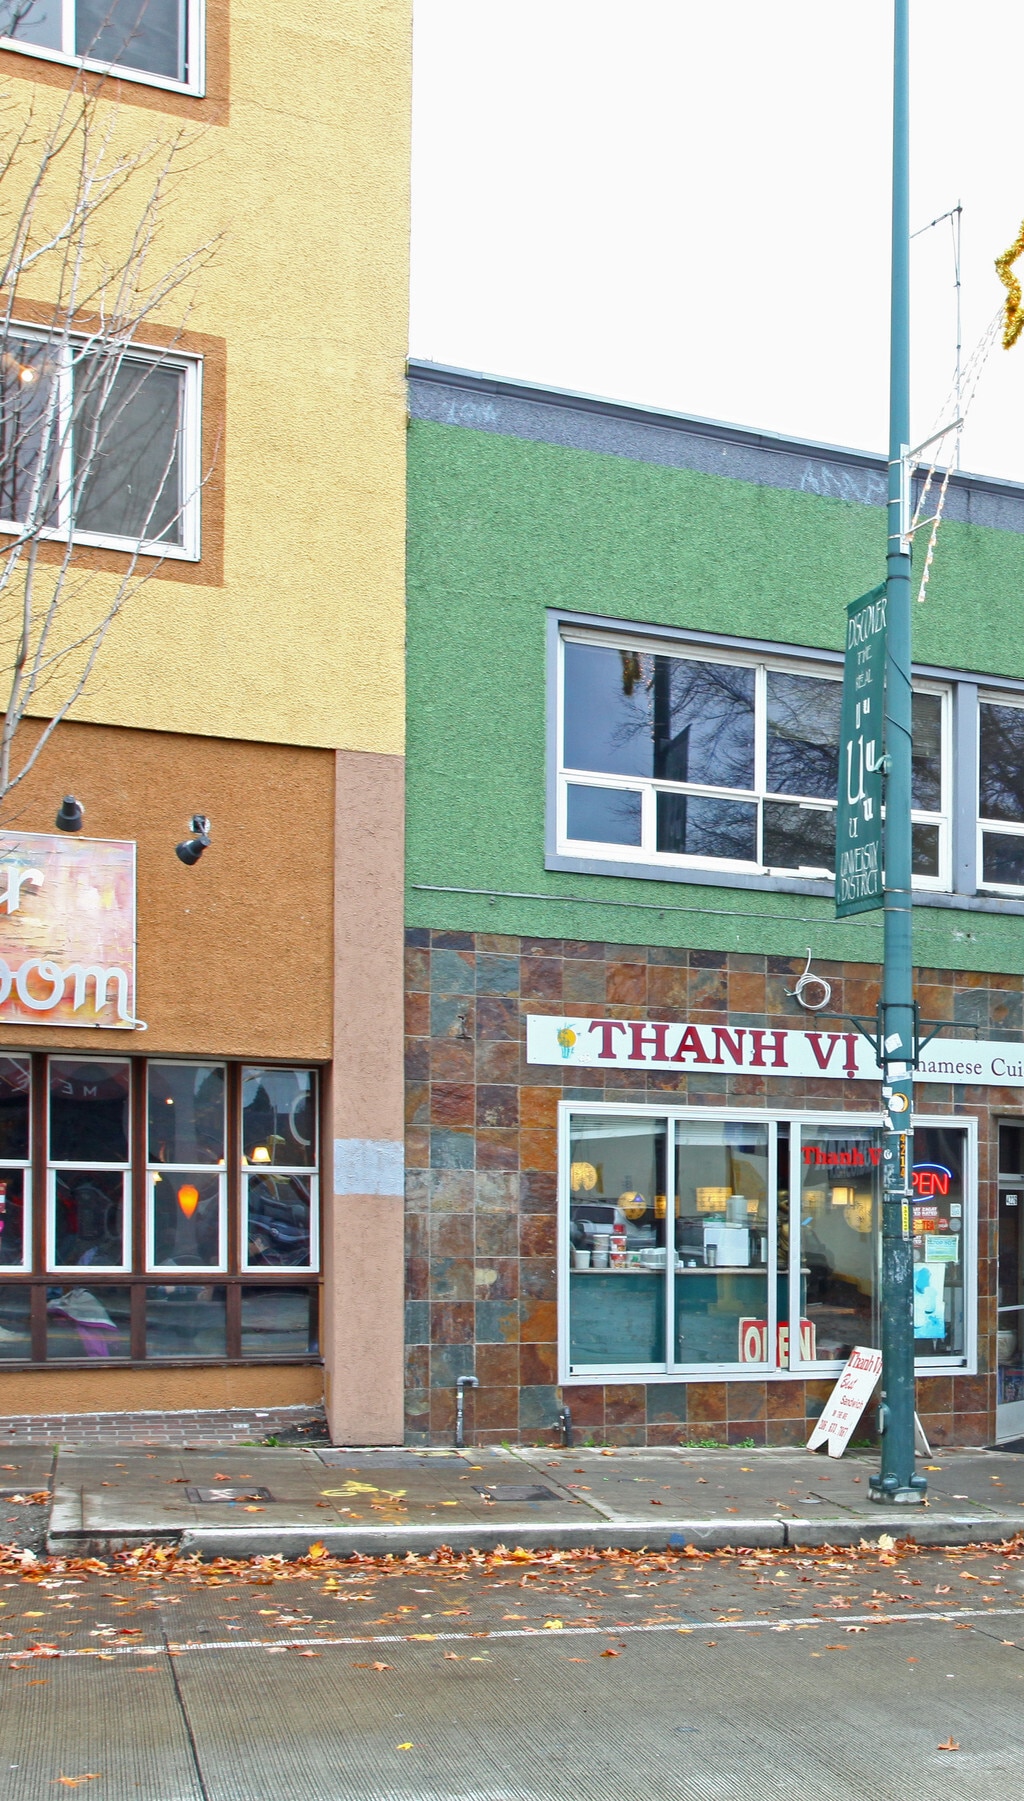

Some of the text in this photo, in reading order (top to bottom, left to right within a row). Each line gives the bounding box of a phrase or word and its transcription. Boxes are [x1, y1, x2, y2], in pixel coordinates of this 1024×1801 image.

[857, 645, 872, 666] THE
[588, 1020, 788, 1068] THANH
[913, 1058, 983, 1077] namese
[801, 1146, 864, 1166] Thanh
[912, 1172, 950, 1196] PEN
